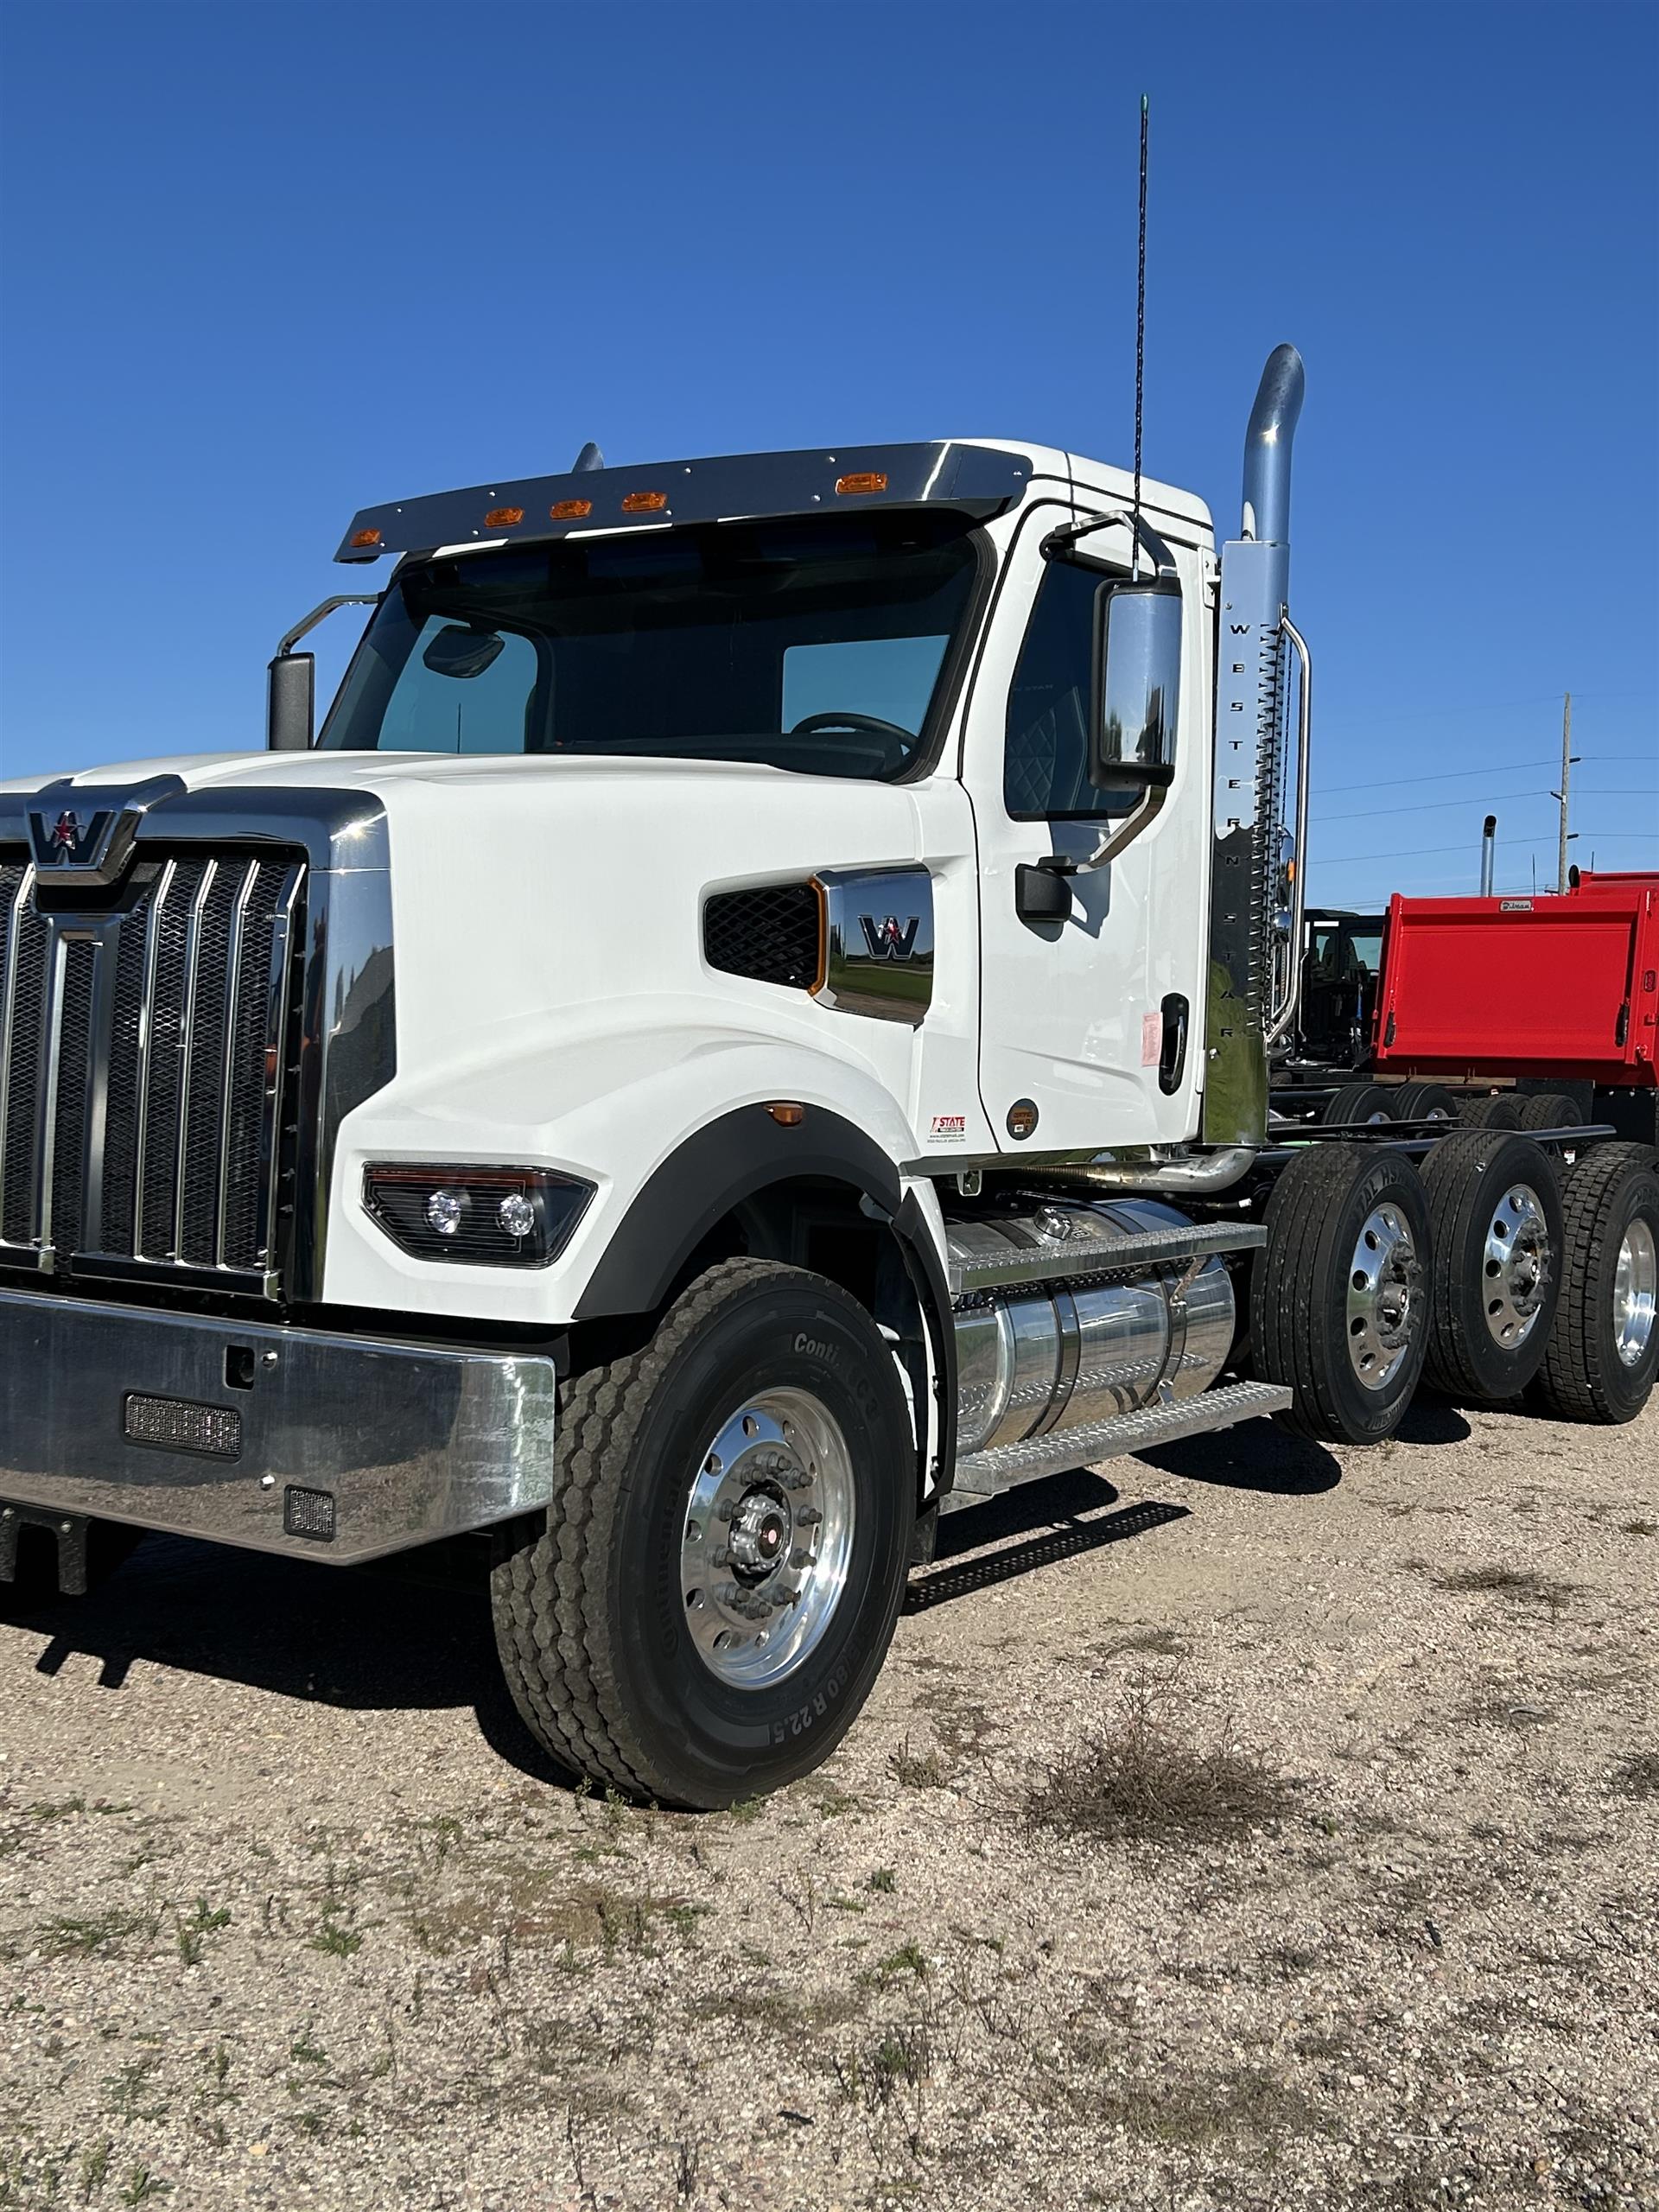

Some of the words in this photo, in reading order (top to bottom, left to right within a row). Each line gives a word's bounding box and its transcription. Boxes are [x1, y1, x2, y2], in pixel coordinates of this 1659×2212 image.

[1225, 624, 1250, 865] WESTERN
[1220, 912, 1236, 1038] STAR
[939, 1116, 966, 1127] STATE
